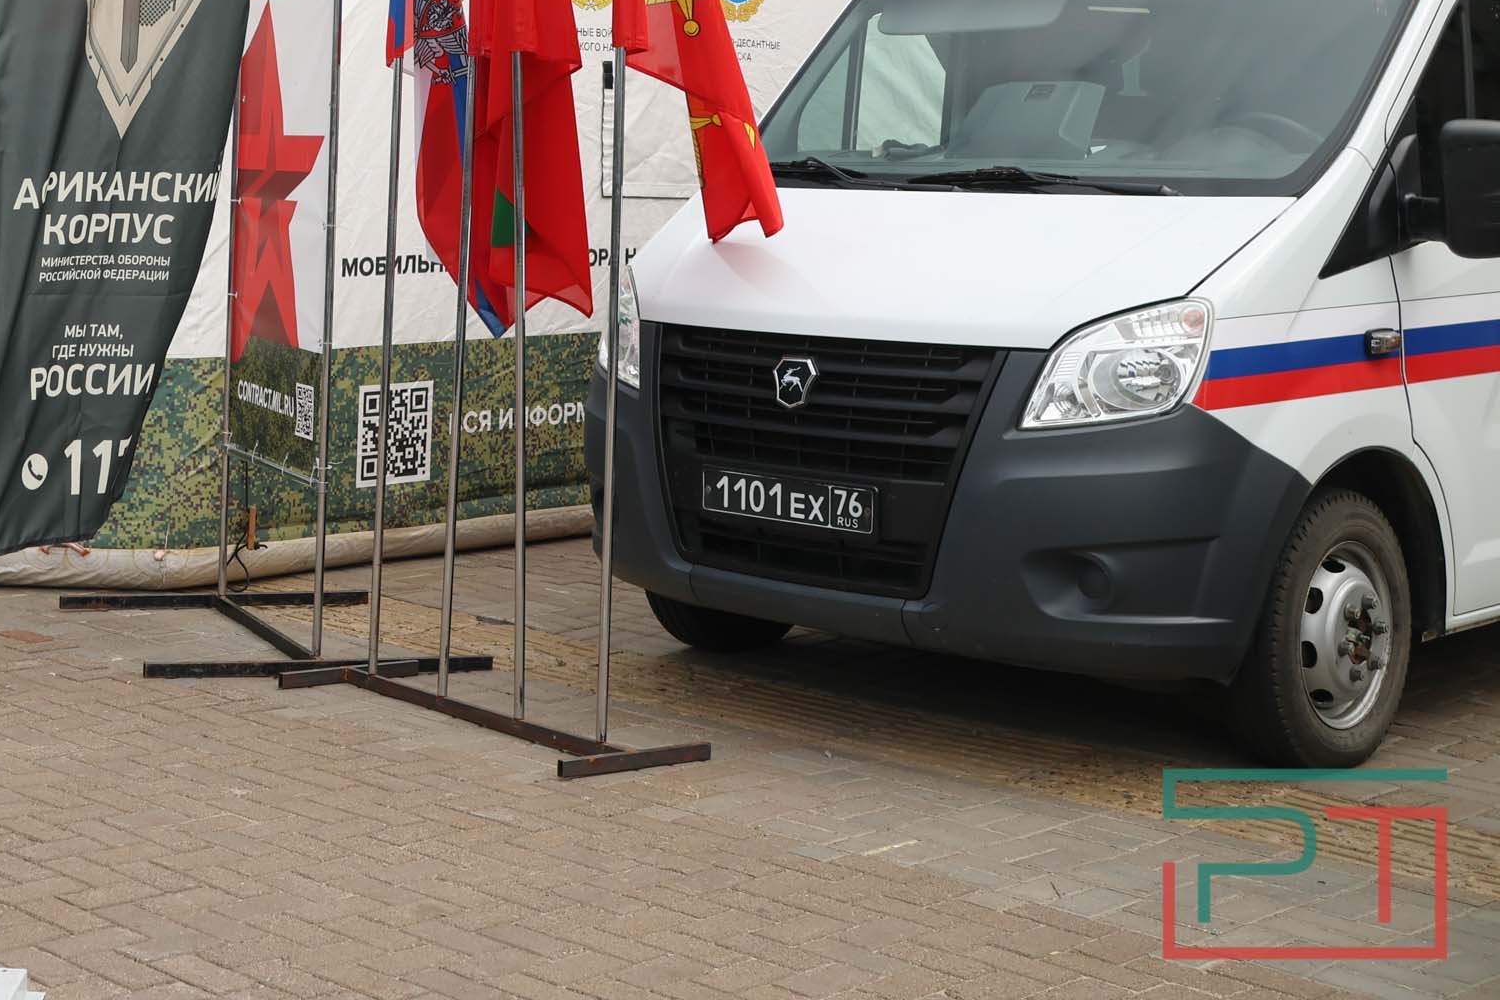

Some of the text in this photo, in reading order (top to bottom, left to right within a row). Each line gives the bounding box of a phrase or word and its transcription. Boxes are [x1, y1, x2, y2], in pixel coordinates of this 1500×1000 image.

[43, 213, 175, 245] КОРПУС
[41, 254, 171, 268] МИНИСТЕРСТВА ОБОРОНЫ
[341, 255, 448, 278] МОБИЛЬН
[39, 267, 169, 283] РОССИЙСКОЙ ФЕДЕРАЦИИ
[64, 324, 124, 340] МЫ ТАМ,
[52, 343, 134, 361] ГДЕ НУЖНЫ
[30, 362, 156, 400] РОССИИ
[237, 379, 295, 418] CONTRACT.MIL.RU
[833, 489, 863, 518] 76
[837, 516, 859, 529] RUS
